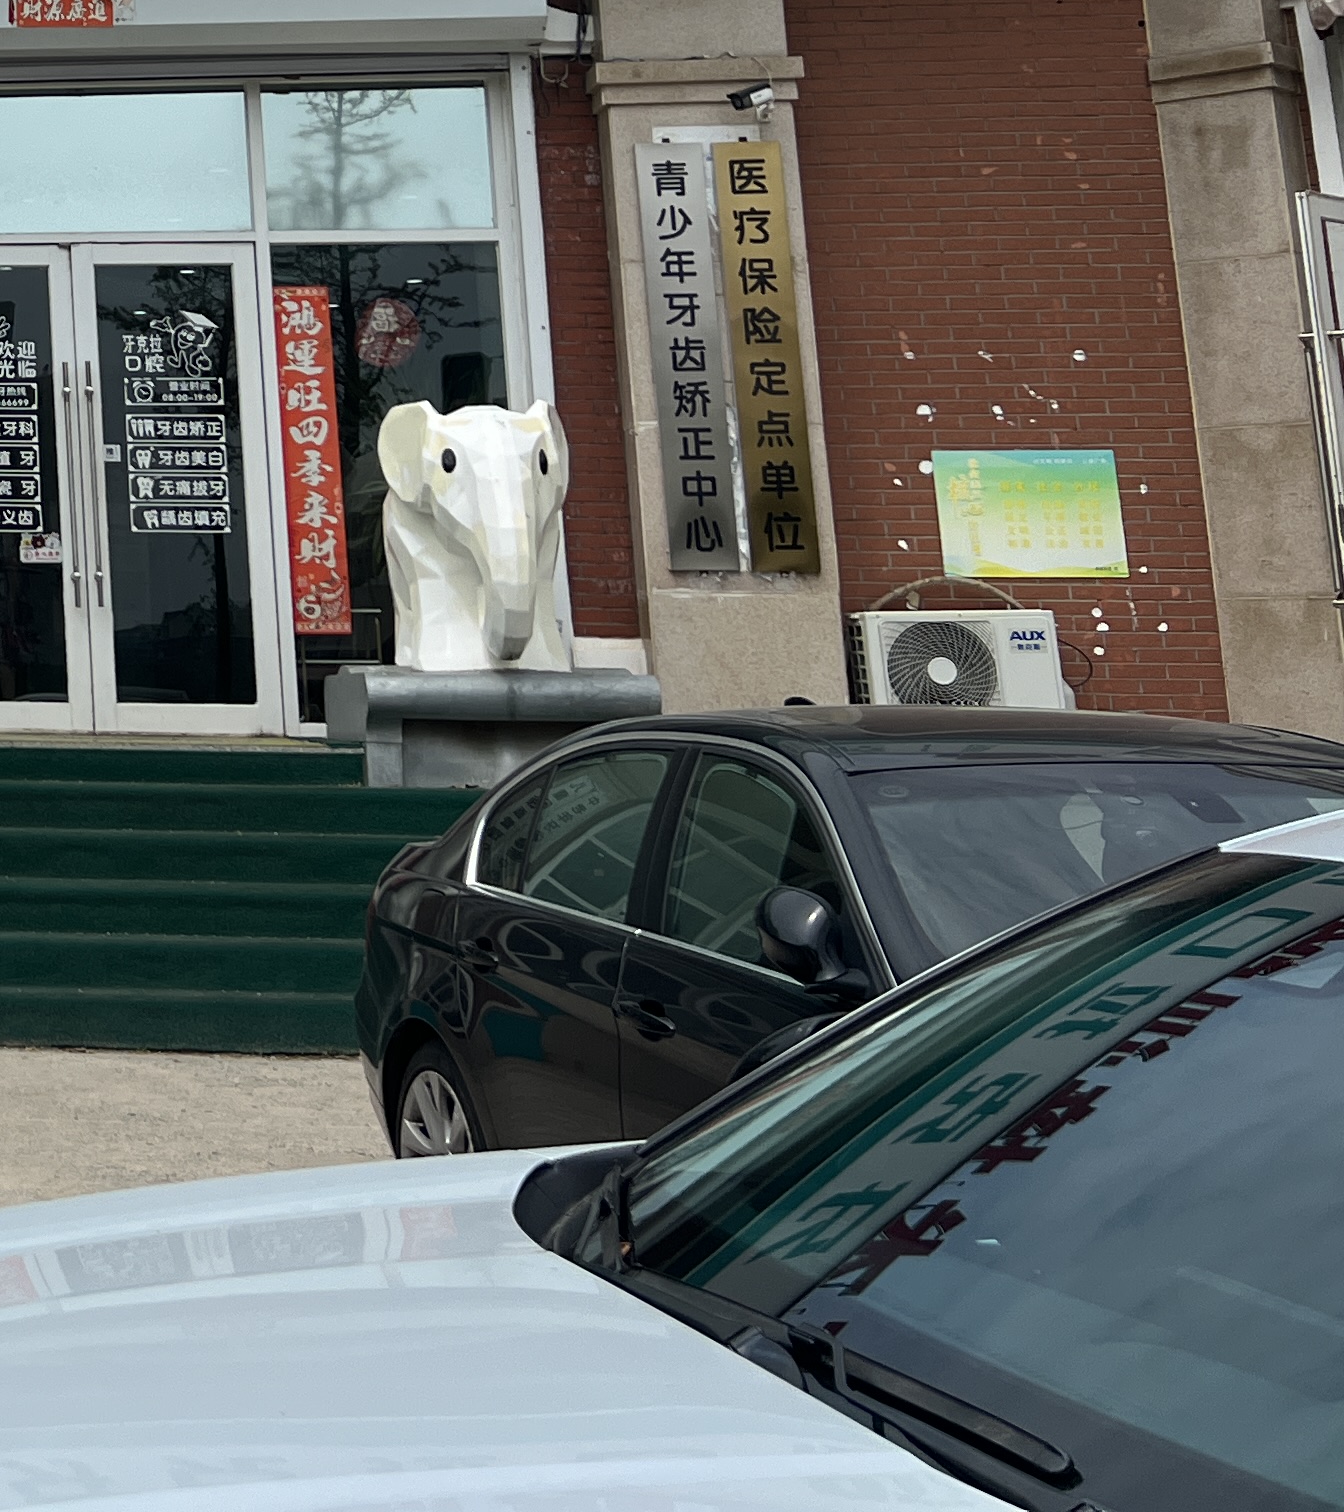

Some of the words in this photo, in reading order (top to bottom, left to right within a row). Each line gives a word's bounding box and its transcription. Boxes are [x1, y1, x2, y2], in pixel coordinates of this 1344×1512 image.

[122, 334, 163, 353] 牙克拉
[125, 354, 165, 372] 口腔
[650, 160, 723, 552] 青少年牙齿矫正中心
[728, 158, 805, 552] 医疗保险定点单位
[156, 420, 221, 436] 牙齿矫正
[158, 450, 223, 466] 牙齿美白
[159, 480, 224, 496] 无痛拔牙
[1010, 631, 1045, 640] AUX
